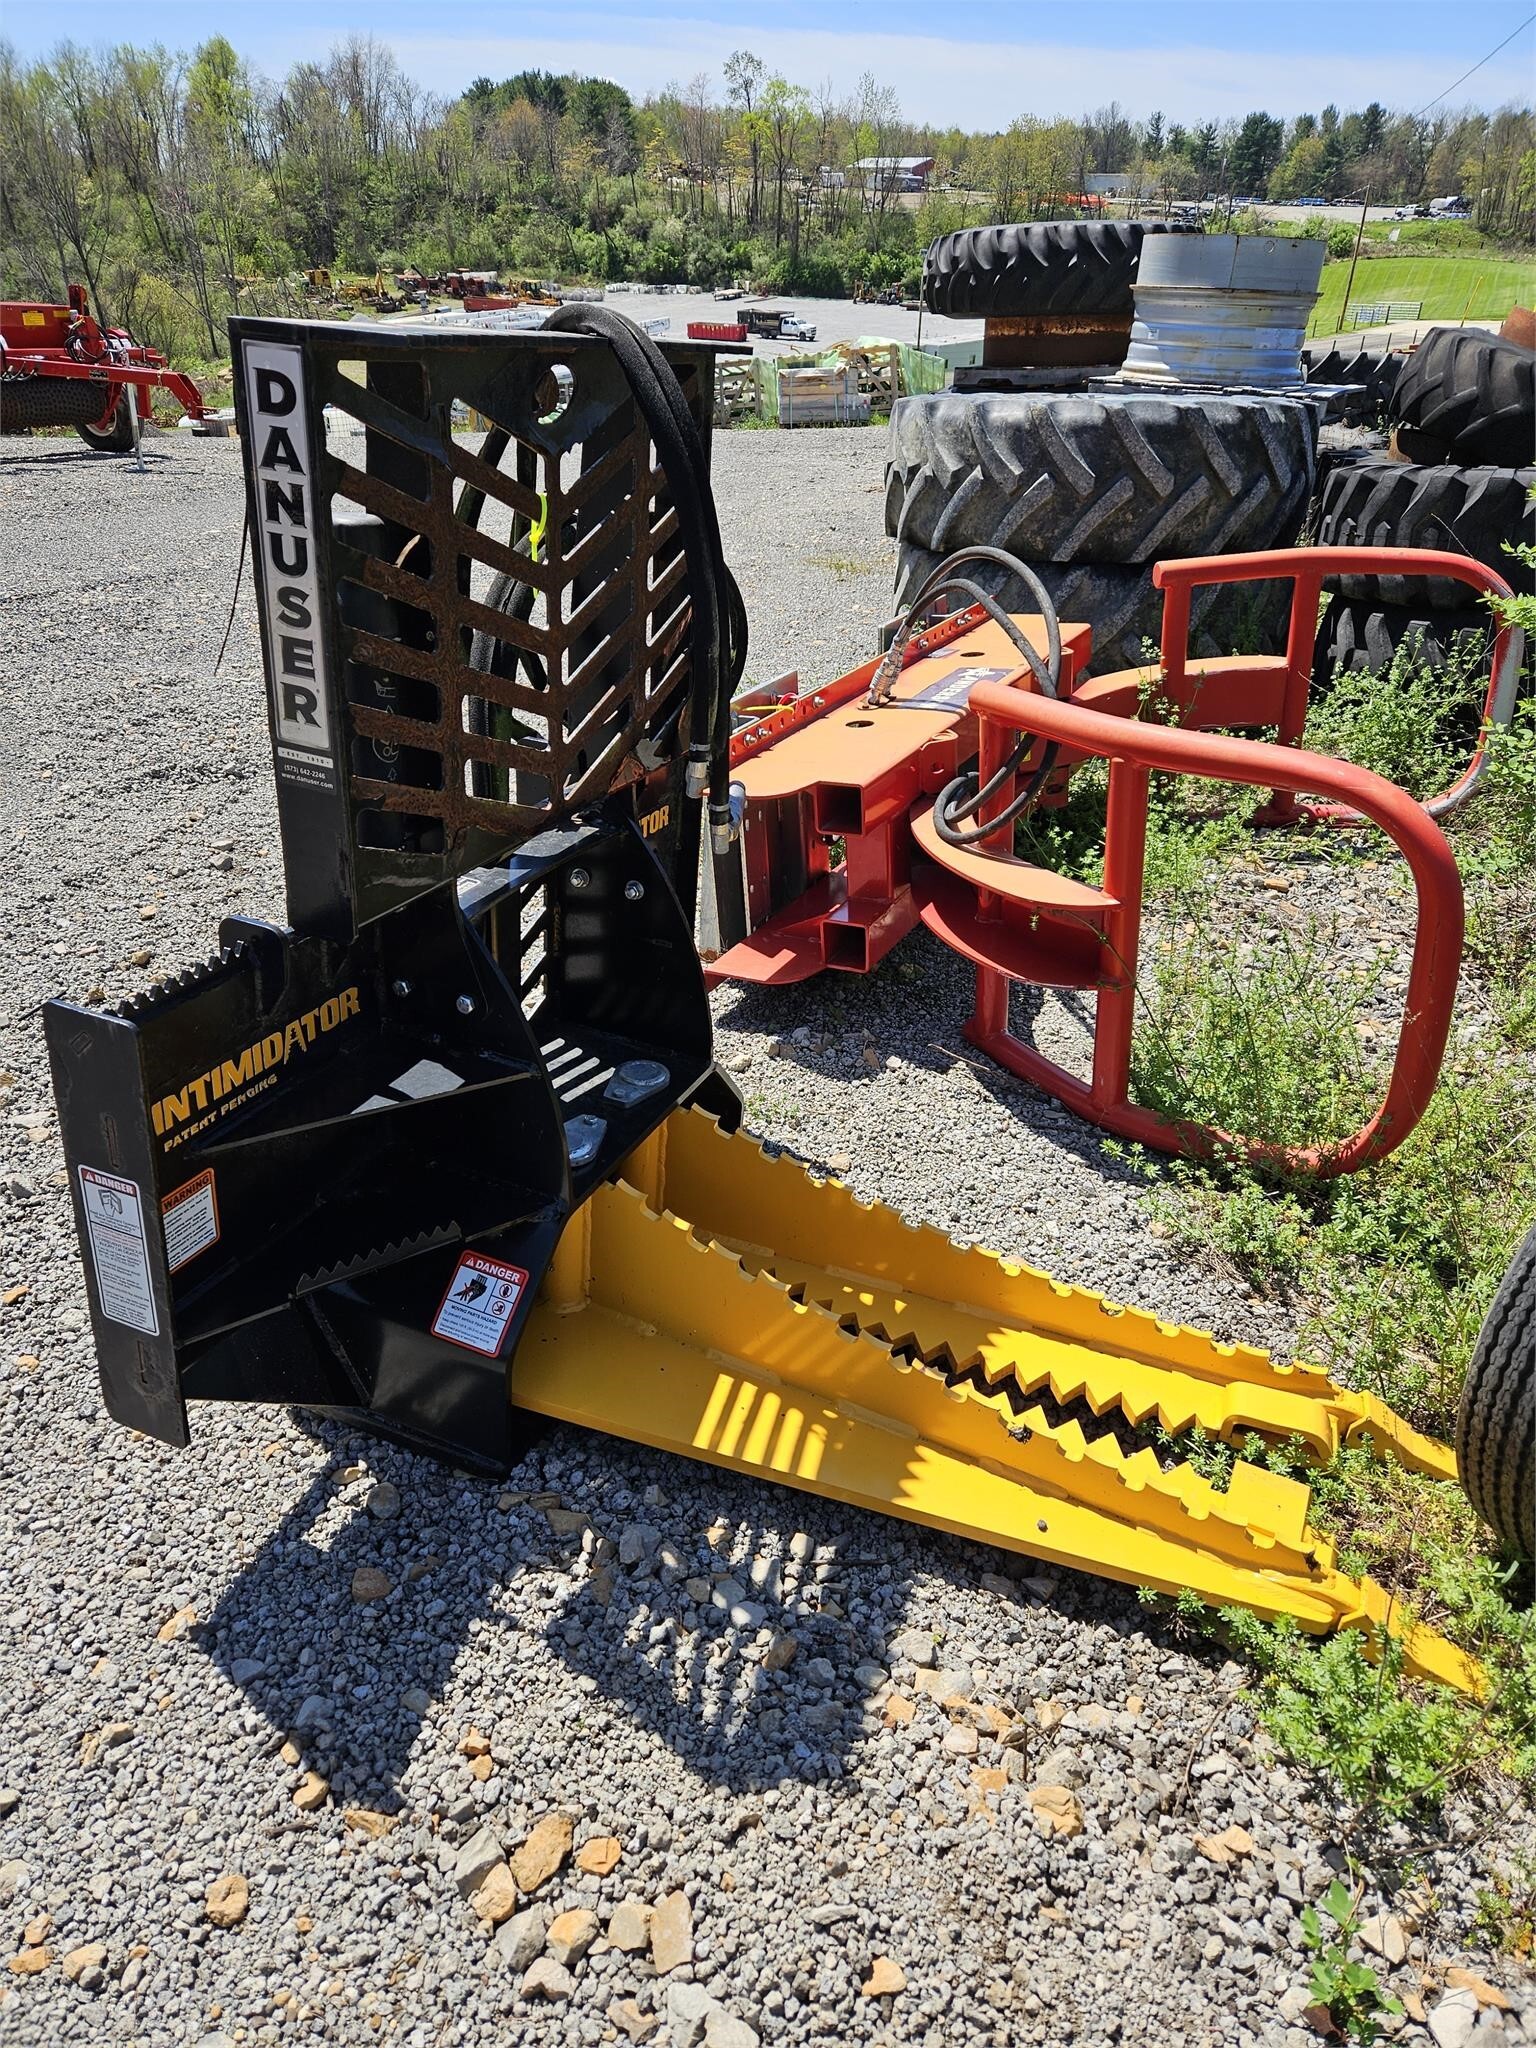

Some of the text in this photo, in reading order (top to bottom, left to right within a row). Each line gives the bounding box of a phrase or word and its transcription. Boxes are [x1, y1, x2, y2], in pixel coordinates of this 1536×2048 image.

[254, 366, 322, 729] DANUSER
[151, 985, 361, 1136] INTIMIDATOR
[163, 1112, 217, 1153] PATENT
[94, 1174, 134, 1195] DANGER
[163, 1175, 210, 1209] WARNING
[475, 1259, 521, 1283] DANGER
